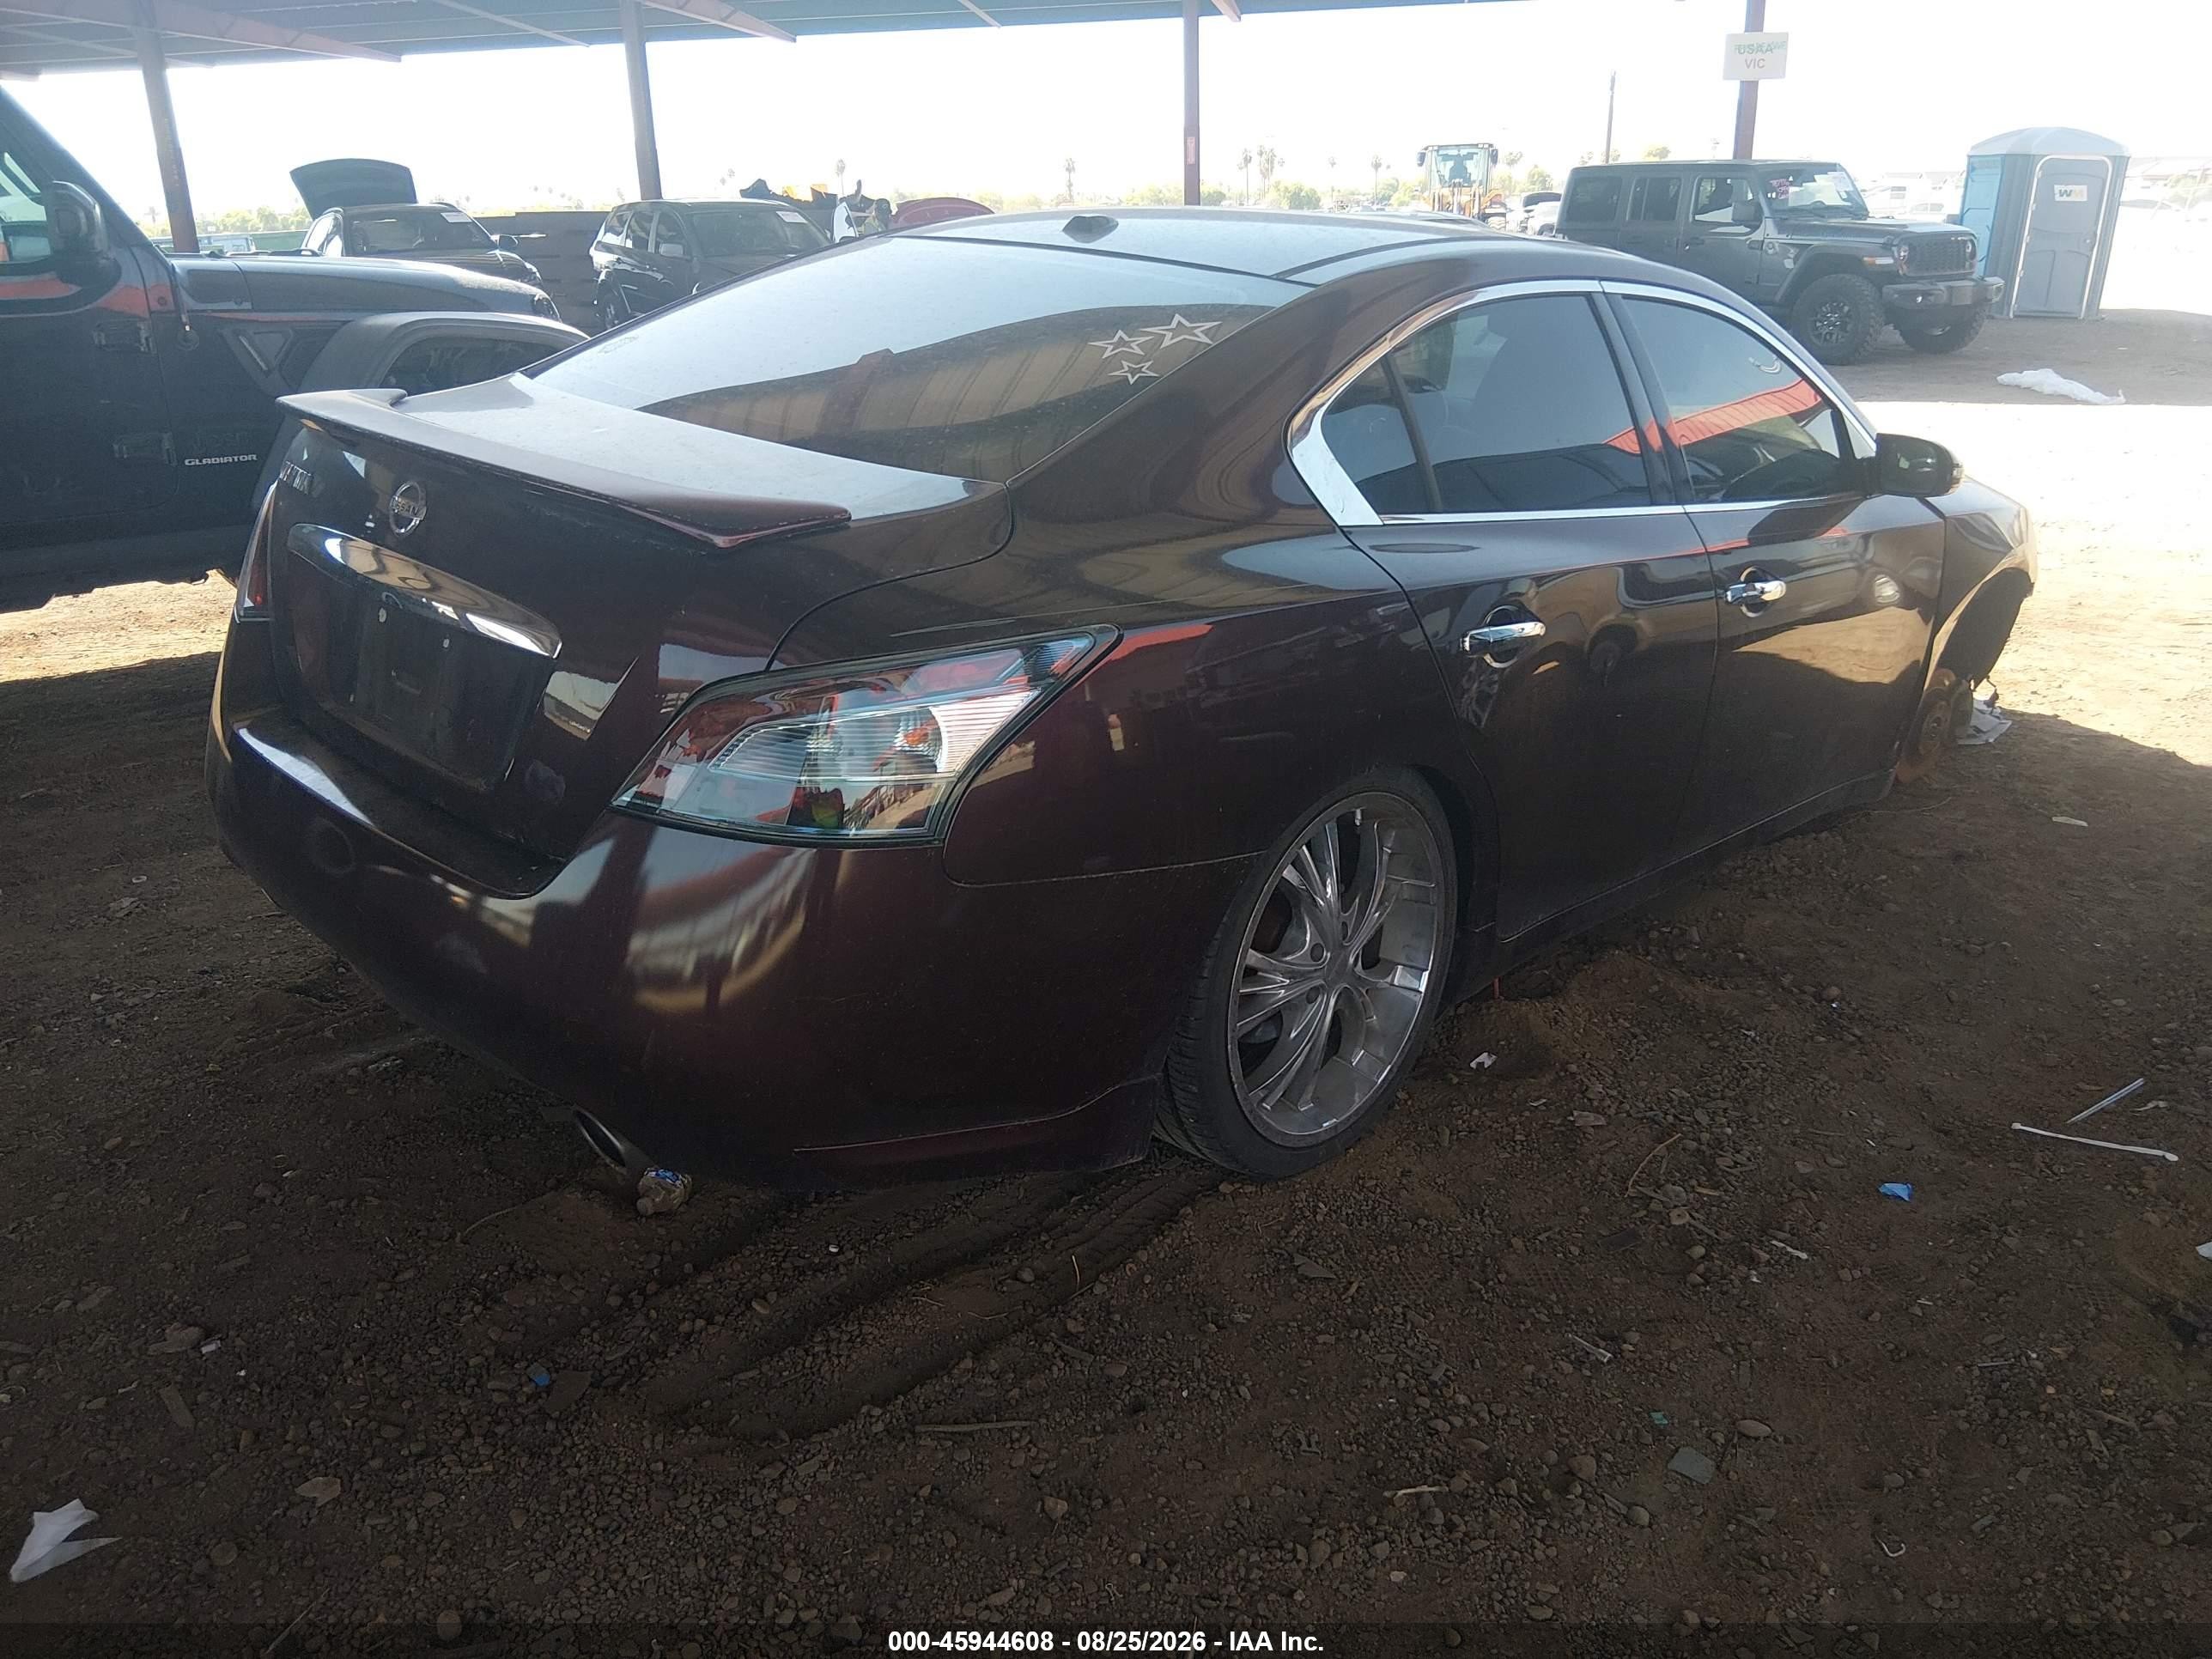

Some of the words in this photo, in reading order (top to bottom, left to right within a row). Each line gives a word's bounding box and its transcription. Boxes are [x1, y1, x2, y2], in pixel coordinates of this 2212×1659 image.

[1744, 58, 1766, 70] VIC
[184, 453, 258, 466] GLADIATOR
[392, 496, 420, 516] SSAN
